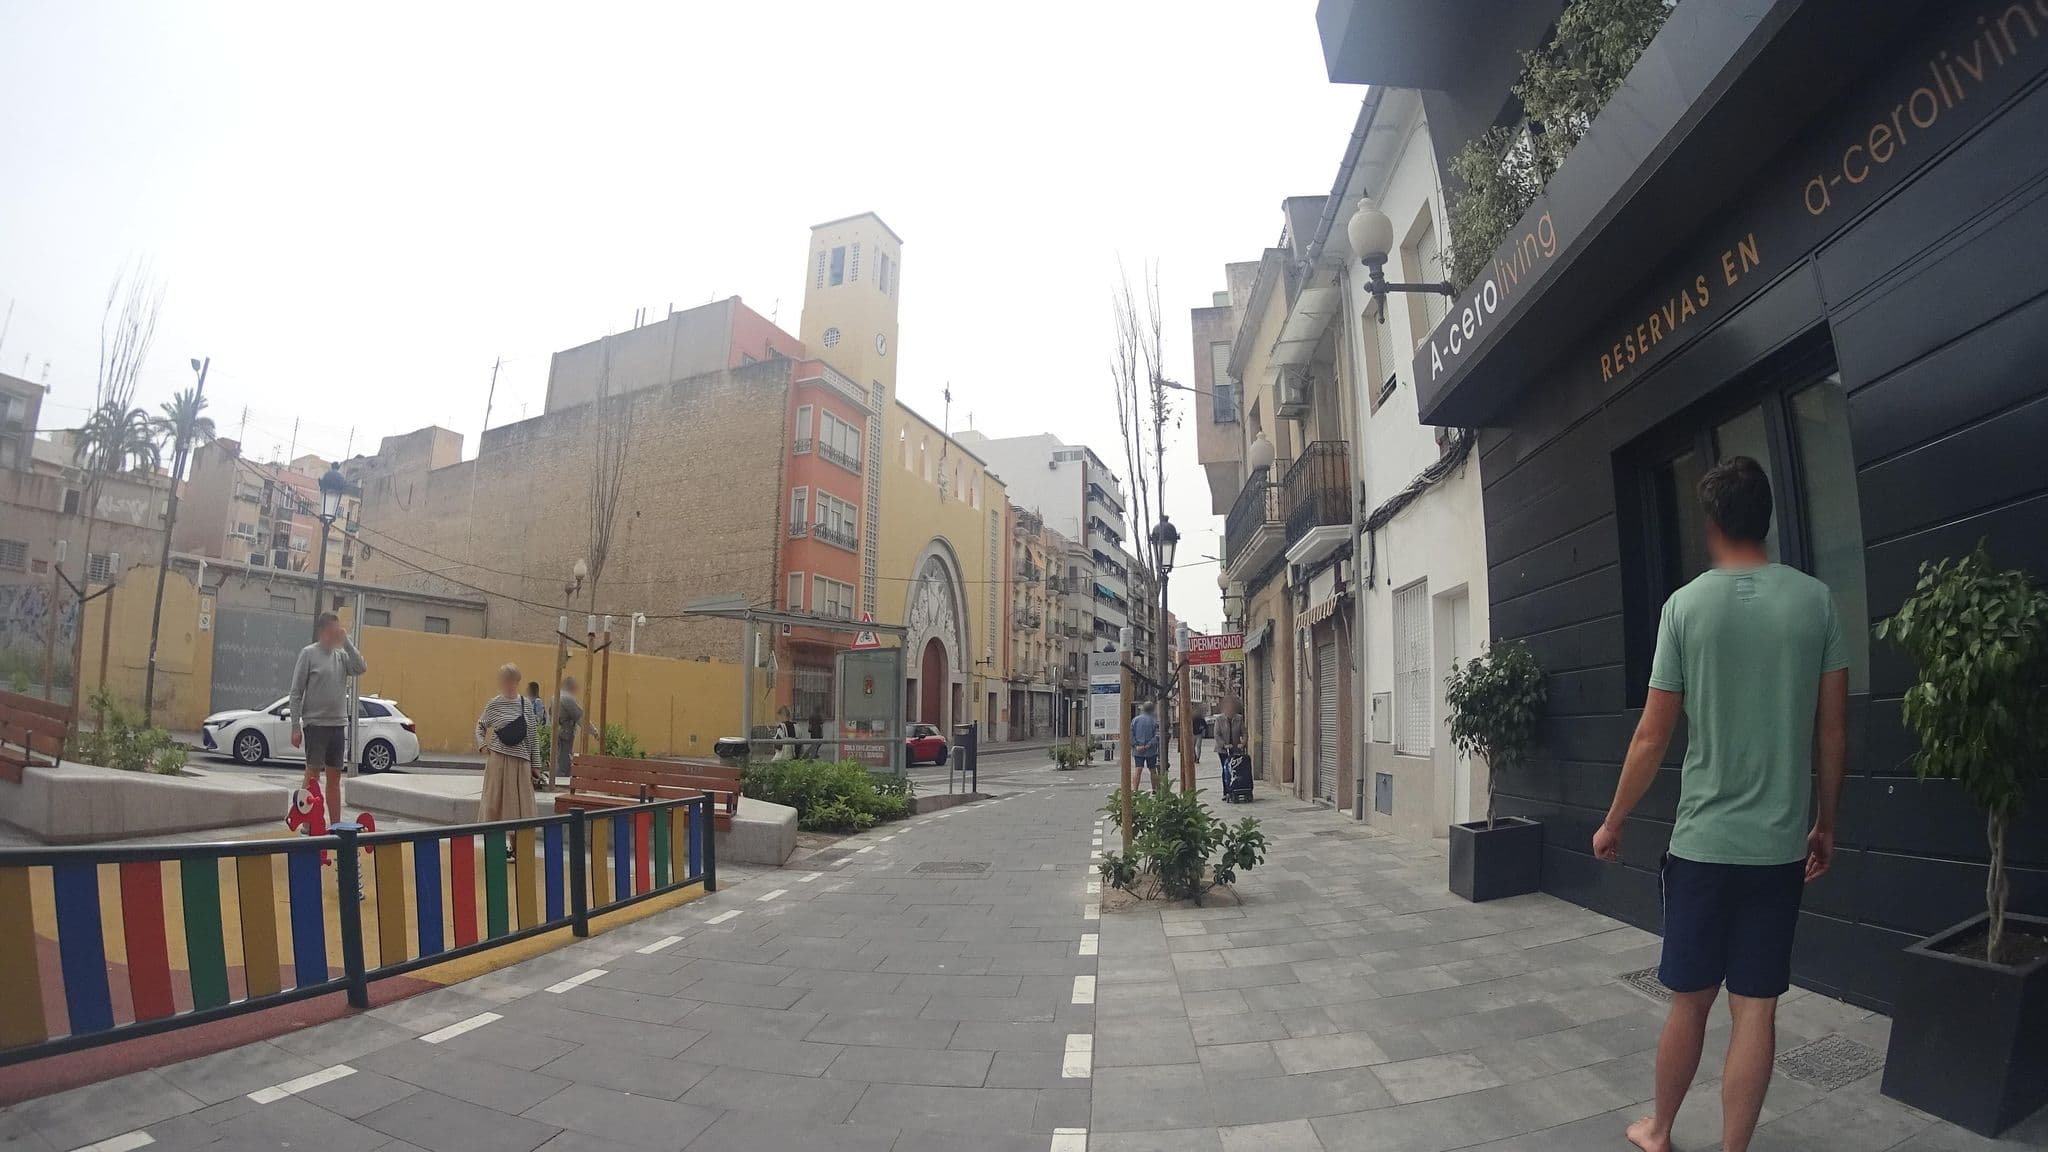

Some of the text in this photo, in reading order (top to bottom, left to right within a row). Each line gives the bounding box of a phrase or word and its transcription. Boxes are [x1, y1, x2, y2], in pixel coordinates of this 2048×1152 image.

[1805, 0, 2048, 215] a-cerolivin
[1428, 211, 1556, 381] A-ceroliving
[1600, 233, 1761, 383] RESERVAS EN
[1188, 635, 1242, 651] UPERMERCADO
